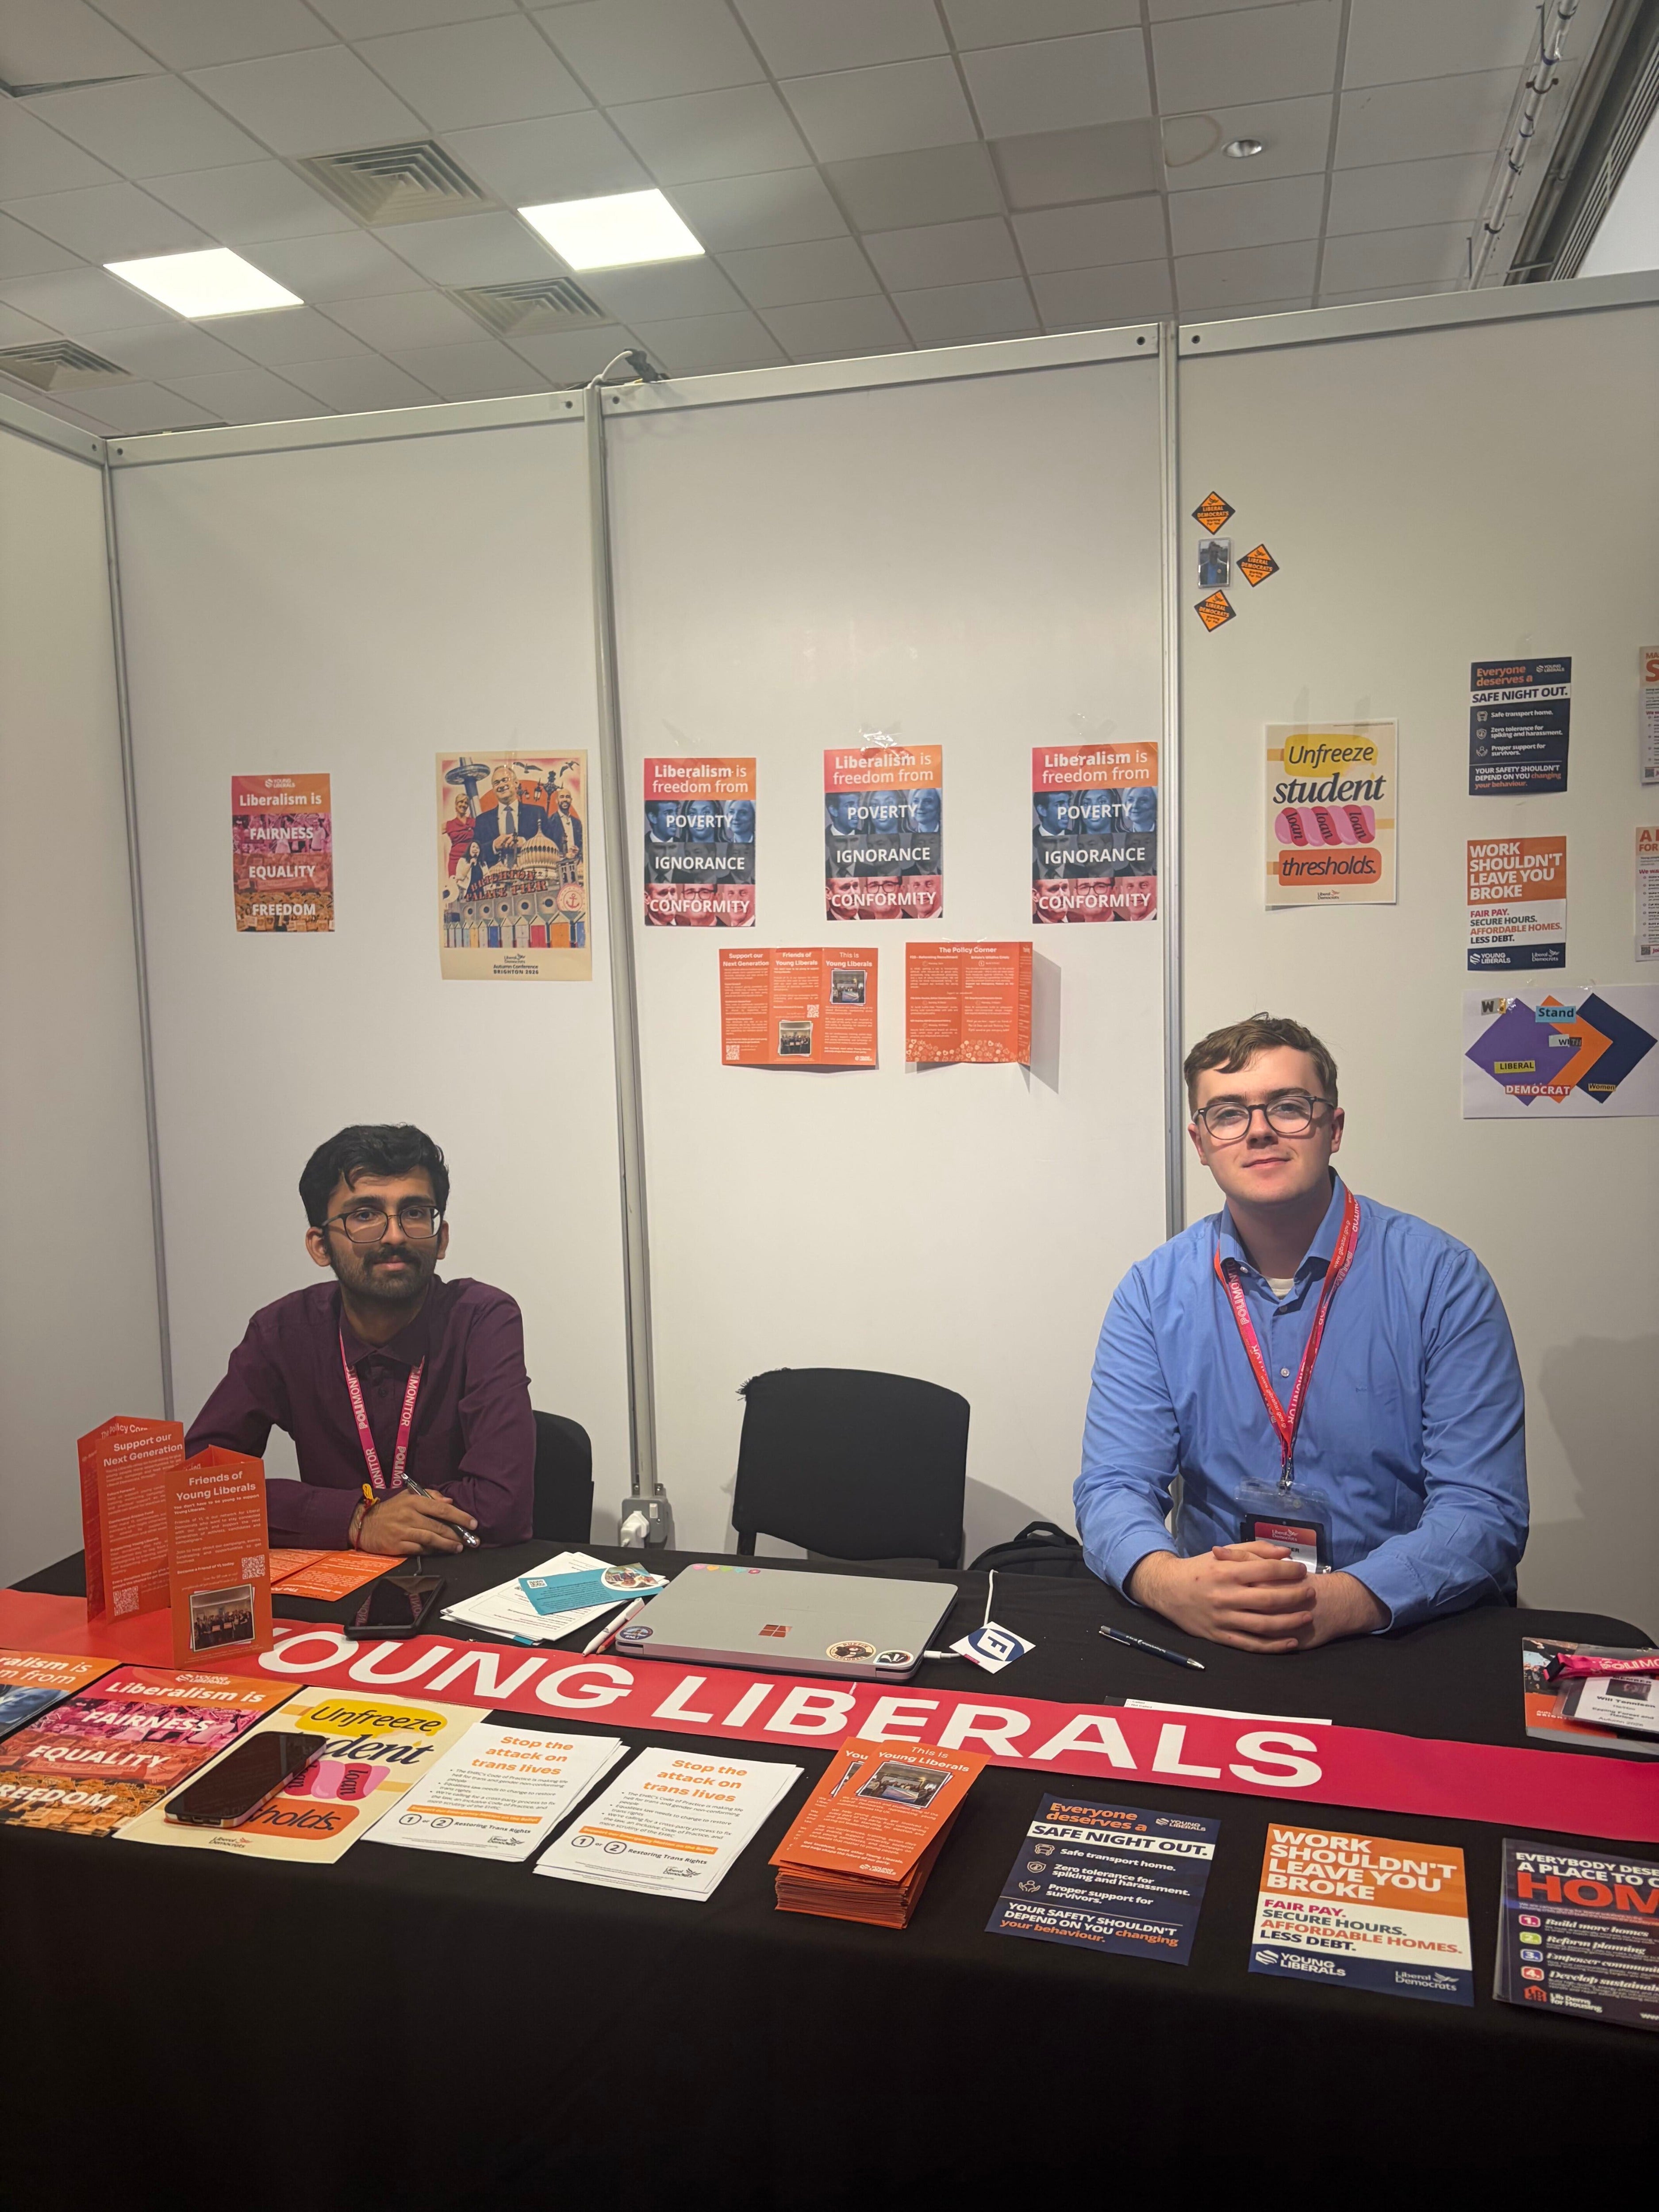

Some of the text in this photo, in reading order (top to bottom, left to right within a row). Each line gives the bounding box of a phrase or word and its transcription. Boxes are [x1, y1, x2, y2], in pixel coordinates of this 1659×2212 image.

[1476, 665, 1526, 677] Everyone
[1476, 676, 1524, 687] deserves
[1472, 686, 1567, 703] SAFE NIGHT OUT.
[835, 753, 931, 769] Liberalism is
[1045, 750, 1147, 768] Liberalism is
[1289, 744, 1374, 769] Unfreeze
[655, 765, 746, 777] Liberalism is
[833, 769, 933, 784] freedom from
[1042, 767, 1149, 783] freedom from
[653, 780, 748, 793] freedom from
[1273, 772, 1386, 804] student
[240, 793, 322, 806] Liberalism is
[848, 804, 917, 820] POVERTY
[1058, 804, 1132, 820] POVERTY
[666, 815, 733, 828] POVERTY
[1286, 812, 1303, 840] loan
[1316, 812, 1333, 839] loan
[1349, 812, 1367, 839] loan
[250, 827, 313, 840] FAIRNESS
[837, 848, 930, 863] IGNORANCE
[1045, 848, 1145, 864] IGNORANCE
[1470, 842, 1521, 858] WORK
[249, 865, 315, 878] EQUALITY
[655, 856, 745, 870] IGNORANCE
[1282, 856, 1376, 876] thresholds.
[1470, 853, 1562, 872] SHOULDN'T
[1471, 868, 1555, 887] LEAVE YOU
[466, 880, 547, 902] PALACE PIER
[832, 892, 936, 907] CONFORMITY
[1471, 885, 1522, 900] BROKE
[252, 904, 315, 915] FREEDOM
[649, 899, 749, 913] CONFORMITY
[1039, 893, 1151, 910] CONFORMITY
[1470, 915, 1537, 926] SECURE HOURS.
[1470, 922, 1562, 935] AFFORDABLE HOMES.
[1538, 1008, 1574, 1018] Stand
[1506, 1085, 1571, 1095] DEMOCRAT
[1225, 1260, 1250, 1325] POLIMONITO
[113, 1433, 172, 1452] Support our
[104, 1443, 183, 1467] Next Generation
[189, 1471, 243, 1486] Friends of
[176, 1483, 256, 1501] Young Liberals
[106, 1682, 265, 1703] Liberalism is
[258, 1628, 1323, 1788] OUNG LIBERALS
[82, 1712, 215, 1732] FAIRNESS
[311, 1706, 441, 1732] Unfreeze
[500, 1736, 574, 1751] Stop the
[911, 1746, 937, 1756] This
[27, 1745, 173, 1769] EQUALITY
[486, 1747, 542, 1762] attack
[878, 1751, 970, 1772] Young Liberals
[472, 1759, 562, 1775] trans lives
[672, 1760, 747, 1776] Stop the
[341, 1768, 369, 1796] loan
[657, 1771, 742, 1789] attack on
[643, 1781, 736, 1802] trans lives
[1050, 1802, 1138, 1821] Everyone
[1046, 1813, 1147, 1832] deserves a
[1032, 1825, 1208, 1856] SAFE NIGHT OUT.
[1272, 1829, 1372, 1853] WORK
[628, 1848, 662, 1858] Restoring
[1087, 1852, 1138, 1866] transport
[1140, 1858, 1176, 1871] home.
[1270, 1844, 1456, 1879] SHOULDN'T
[1516, 1852, 1617, 1871] EVERYBODY
[1269, 1859, 1441, 1892] LEAVE YOU
[1517, 1862, 1644, 1886] A PLACE TO
[1267, 1874, 1375, 1901] BROKE
[1264, 1899, 1346, 1918] FAIR PAY.
[1009, 1902, 1177, 1936] YOUR SAFETY SHOULDN'T
[1262, 1910, 1407, 1936] SECURE HOURS.
[1545, 1919, 1578, 1928] Build
[1578, 1923, 1609, 1932] more
[1611, 1926, 1649, 1937] homes
[1000, 1920, 1106, 1942] your behaviour.
[1004, 1911, 1179, 1947] DEPEND ON YOU changing
[1261, 1920, 1463, 1954] AFFORDABLE HOMES.
[1260, 1930, 1356, 1951] LESS DEBT.
[1547, 1936, 1591, 1947] Reform
[1593, 1941, 1646, 1955] planning
[1280, 1952, 1336, 1968] YOUNG
[1280, 1960, 1346, 1977] LIBERALS
[1395, 1971, 1431, 1981] Liberal
[1395, 1977, 1456, 1991] Democrats
